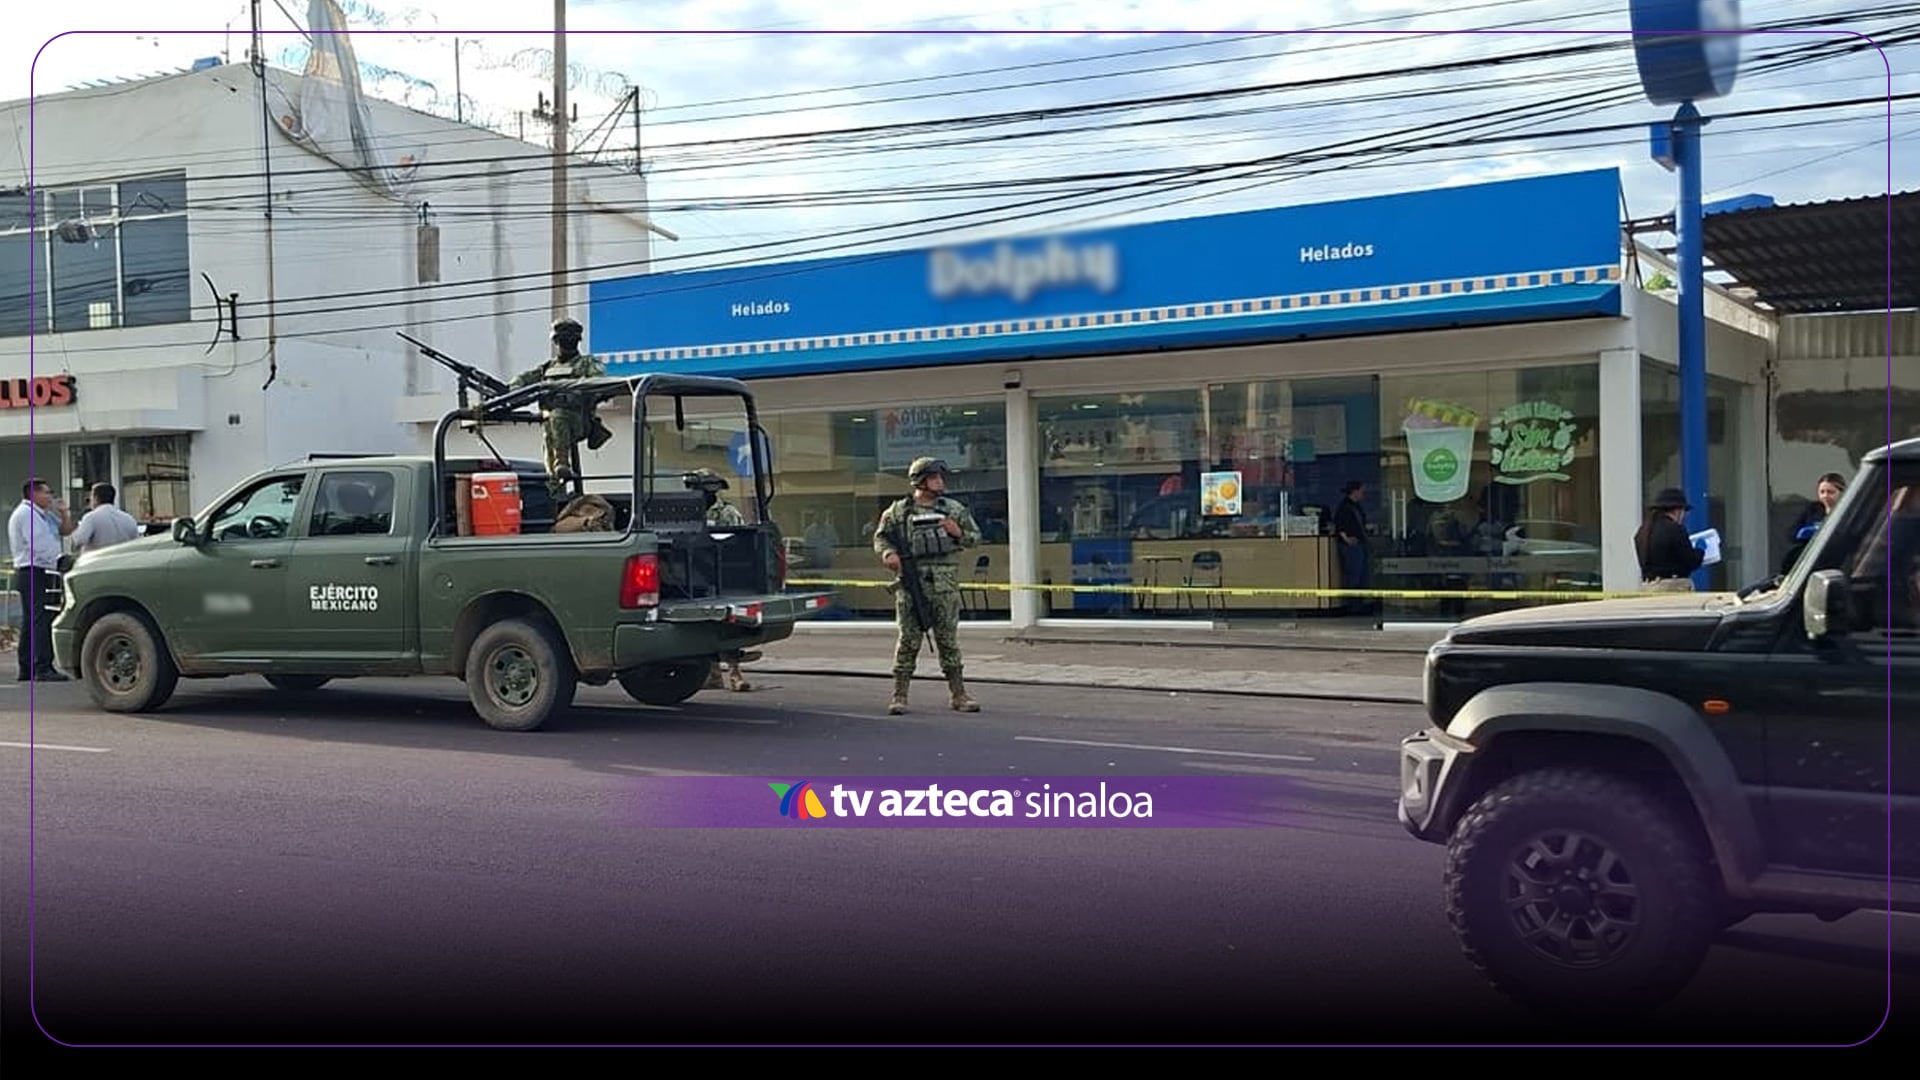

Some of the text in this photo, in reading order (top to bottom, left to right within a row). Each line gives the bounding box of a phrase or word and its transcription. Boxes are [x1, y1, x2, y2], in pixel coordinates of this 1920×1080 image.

[1300, 242, 1374, 263] Helados
[731, 300, 791, 317] Helados
[309, 583, 378, 600] EJÉRCITO
[311, 600, 378, 611] MEXICANO
